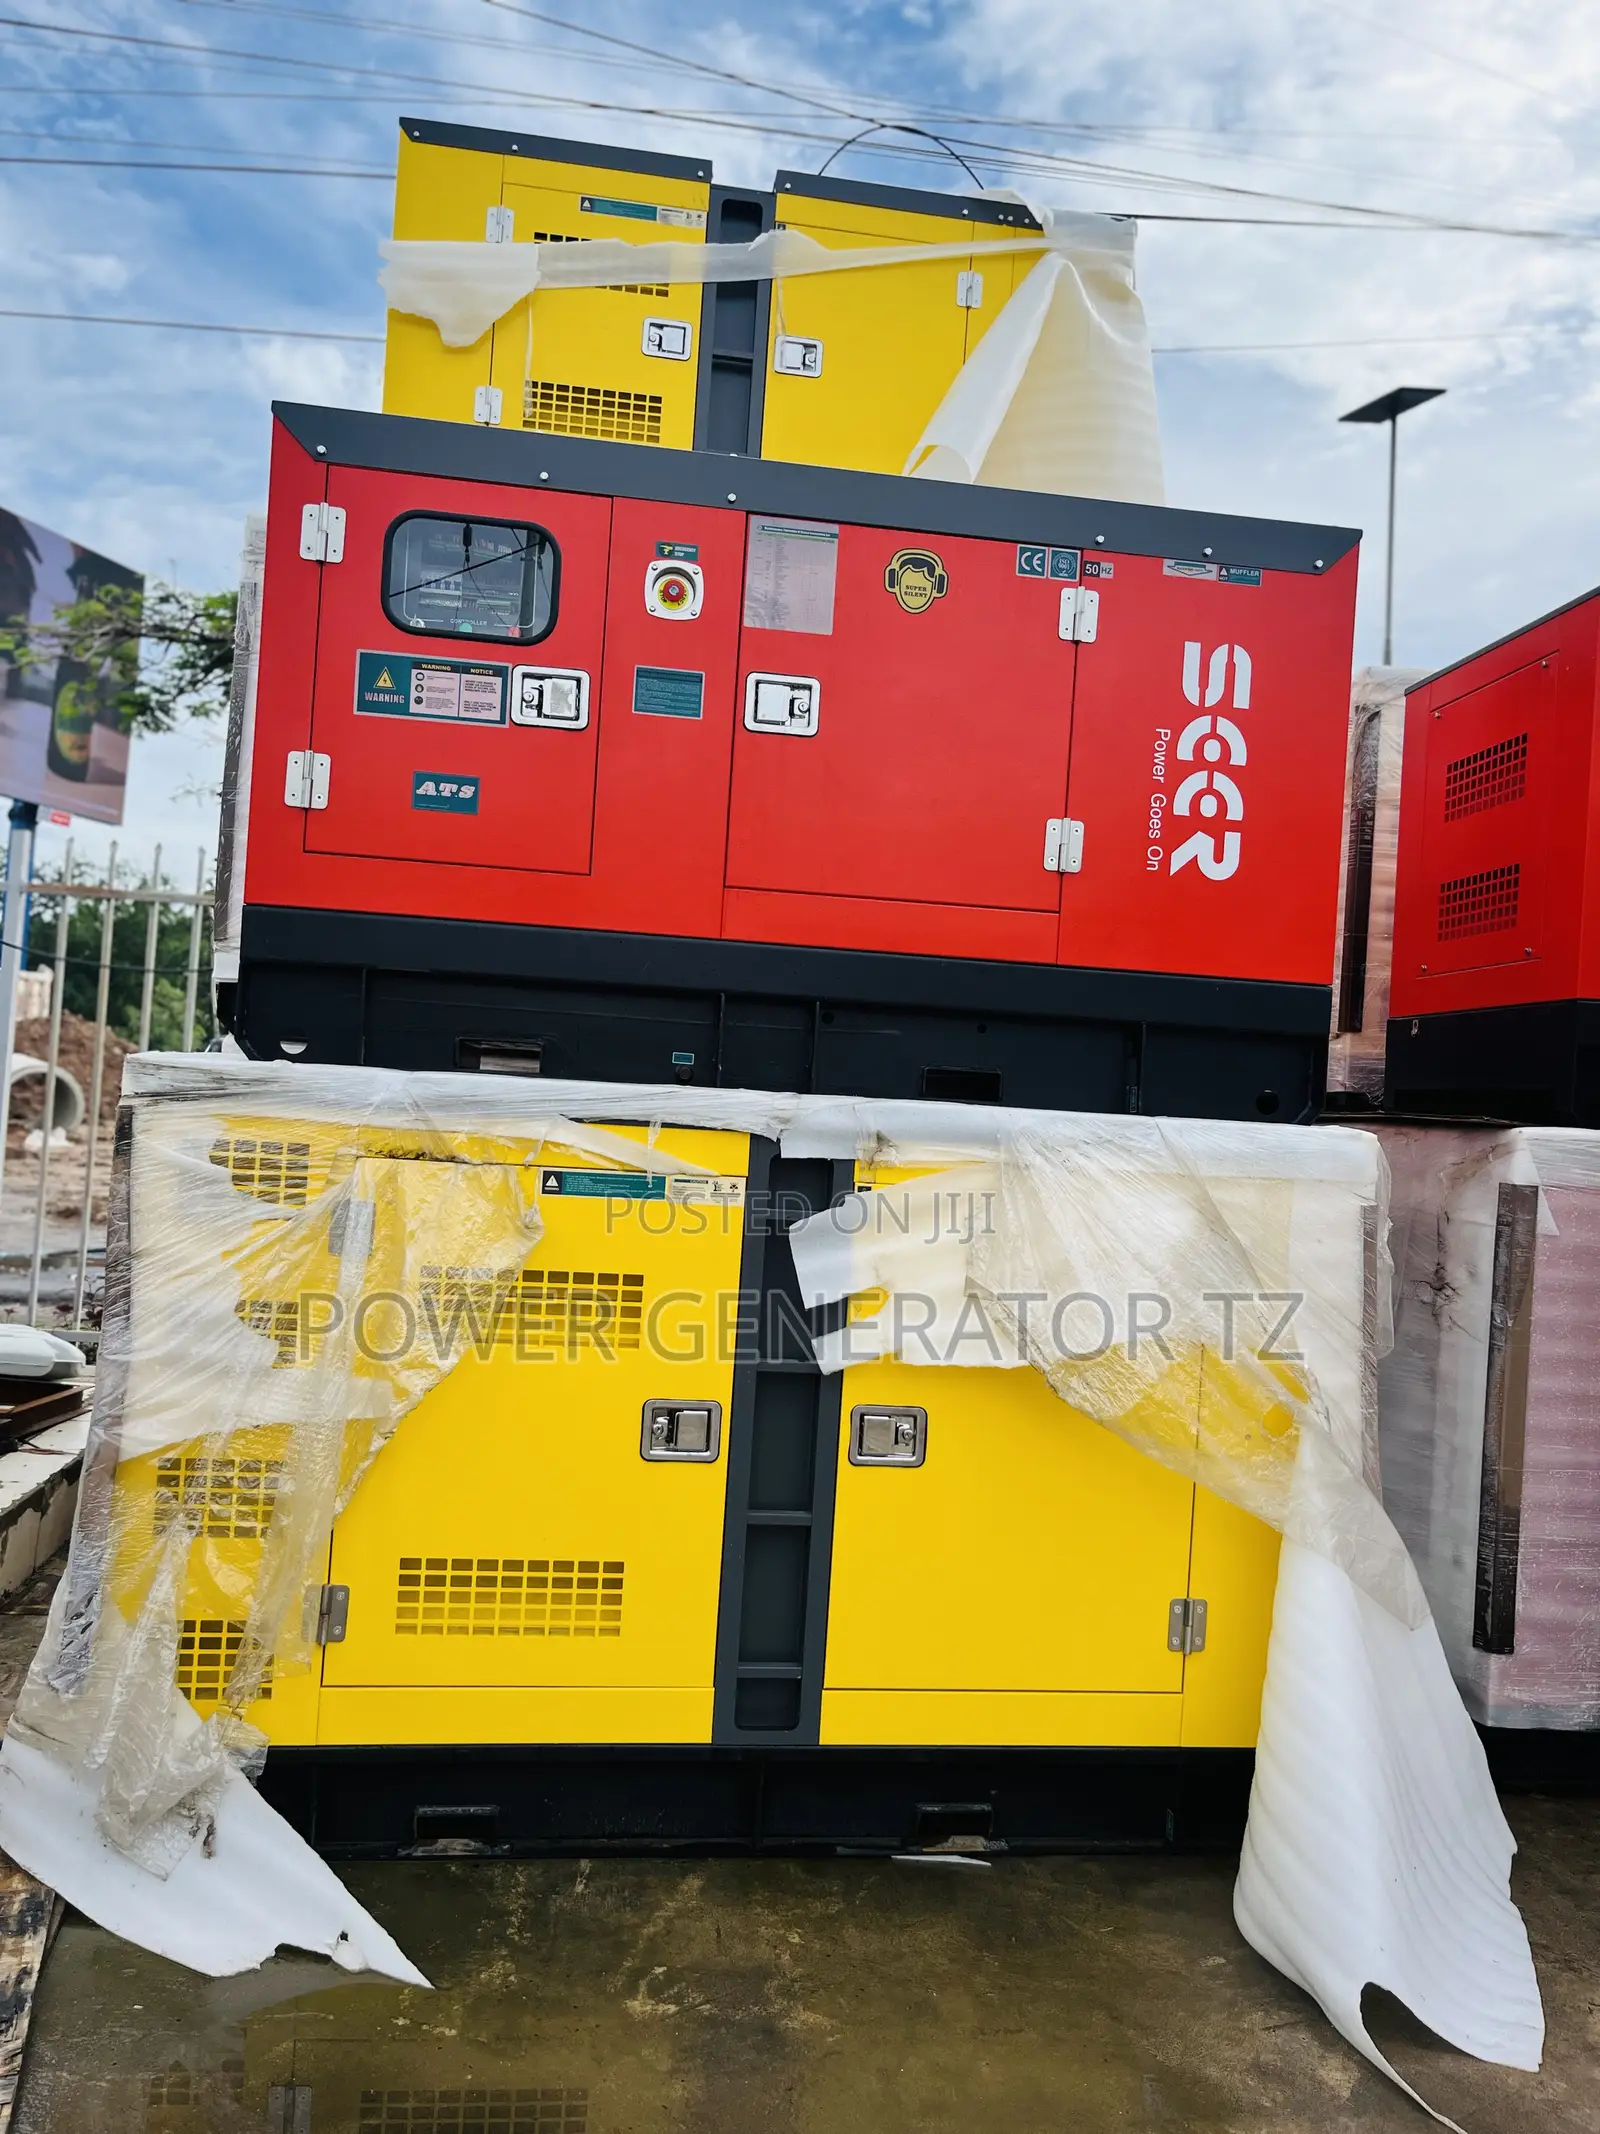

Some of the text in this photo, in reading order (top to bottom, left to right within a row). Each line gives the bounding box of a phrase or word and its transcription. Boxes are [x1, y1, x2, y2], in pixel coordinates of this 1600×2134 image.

[1021, 551, 1044, 572] CE
[1085, 563, 1113, 575] 50 HZ
[1229, 568, 1260, 577] MUFFLER
[905, 584, 927, 592] SUPER
[421, 663, 452, 672] WARNING
[364, 691, 405, 704] WARNING
[1146, 727, 1171, 871] Power Goes On
